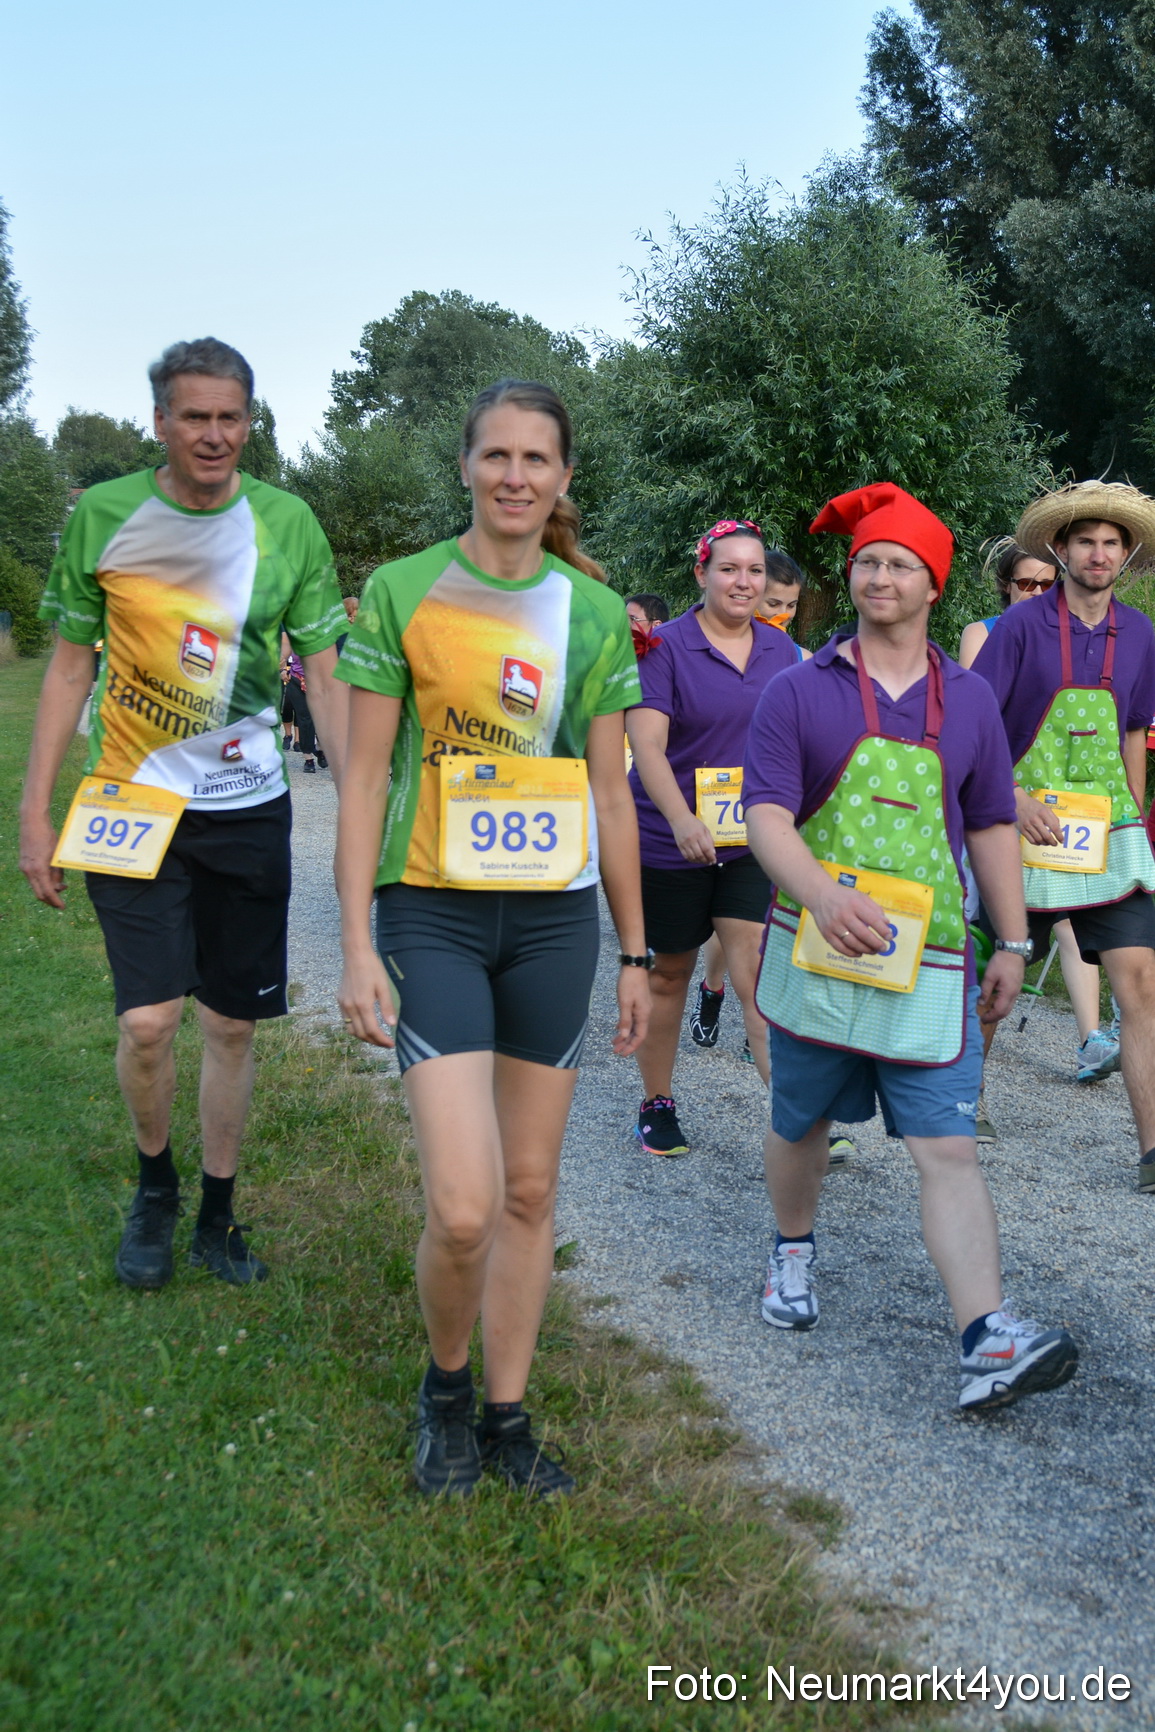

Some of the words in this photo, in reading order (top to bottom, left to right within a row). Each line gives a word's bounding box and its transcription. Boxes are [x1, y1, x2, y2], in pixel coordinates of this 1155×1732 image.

[186, 664, 205, 679] 1628
[507, 702, 528, 716] 1628
[204, 764, 262, 782] Neumarkter
[85, 816, 154, 850] 997
[470, 810, 558, 853] 983
[1060, 824, 1091, 851] 12
[480, 861, 510, 870] Sabine
[511, 861, 549, 870] Kuschka
[826, 951, 853, 964] Steffen
[853, 958, 884, 972] Schmidt
